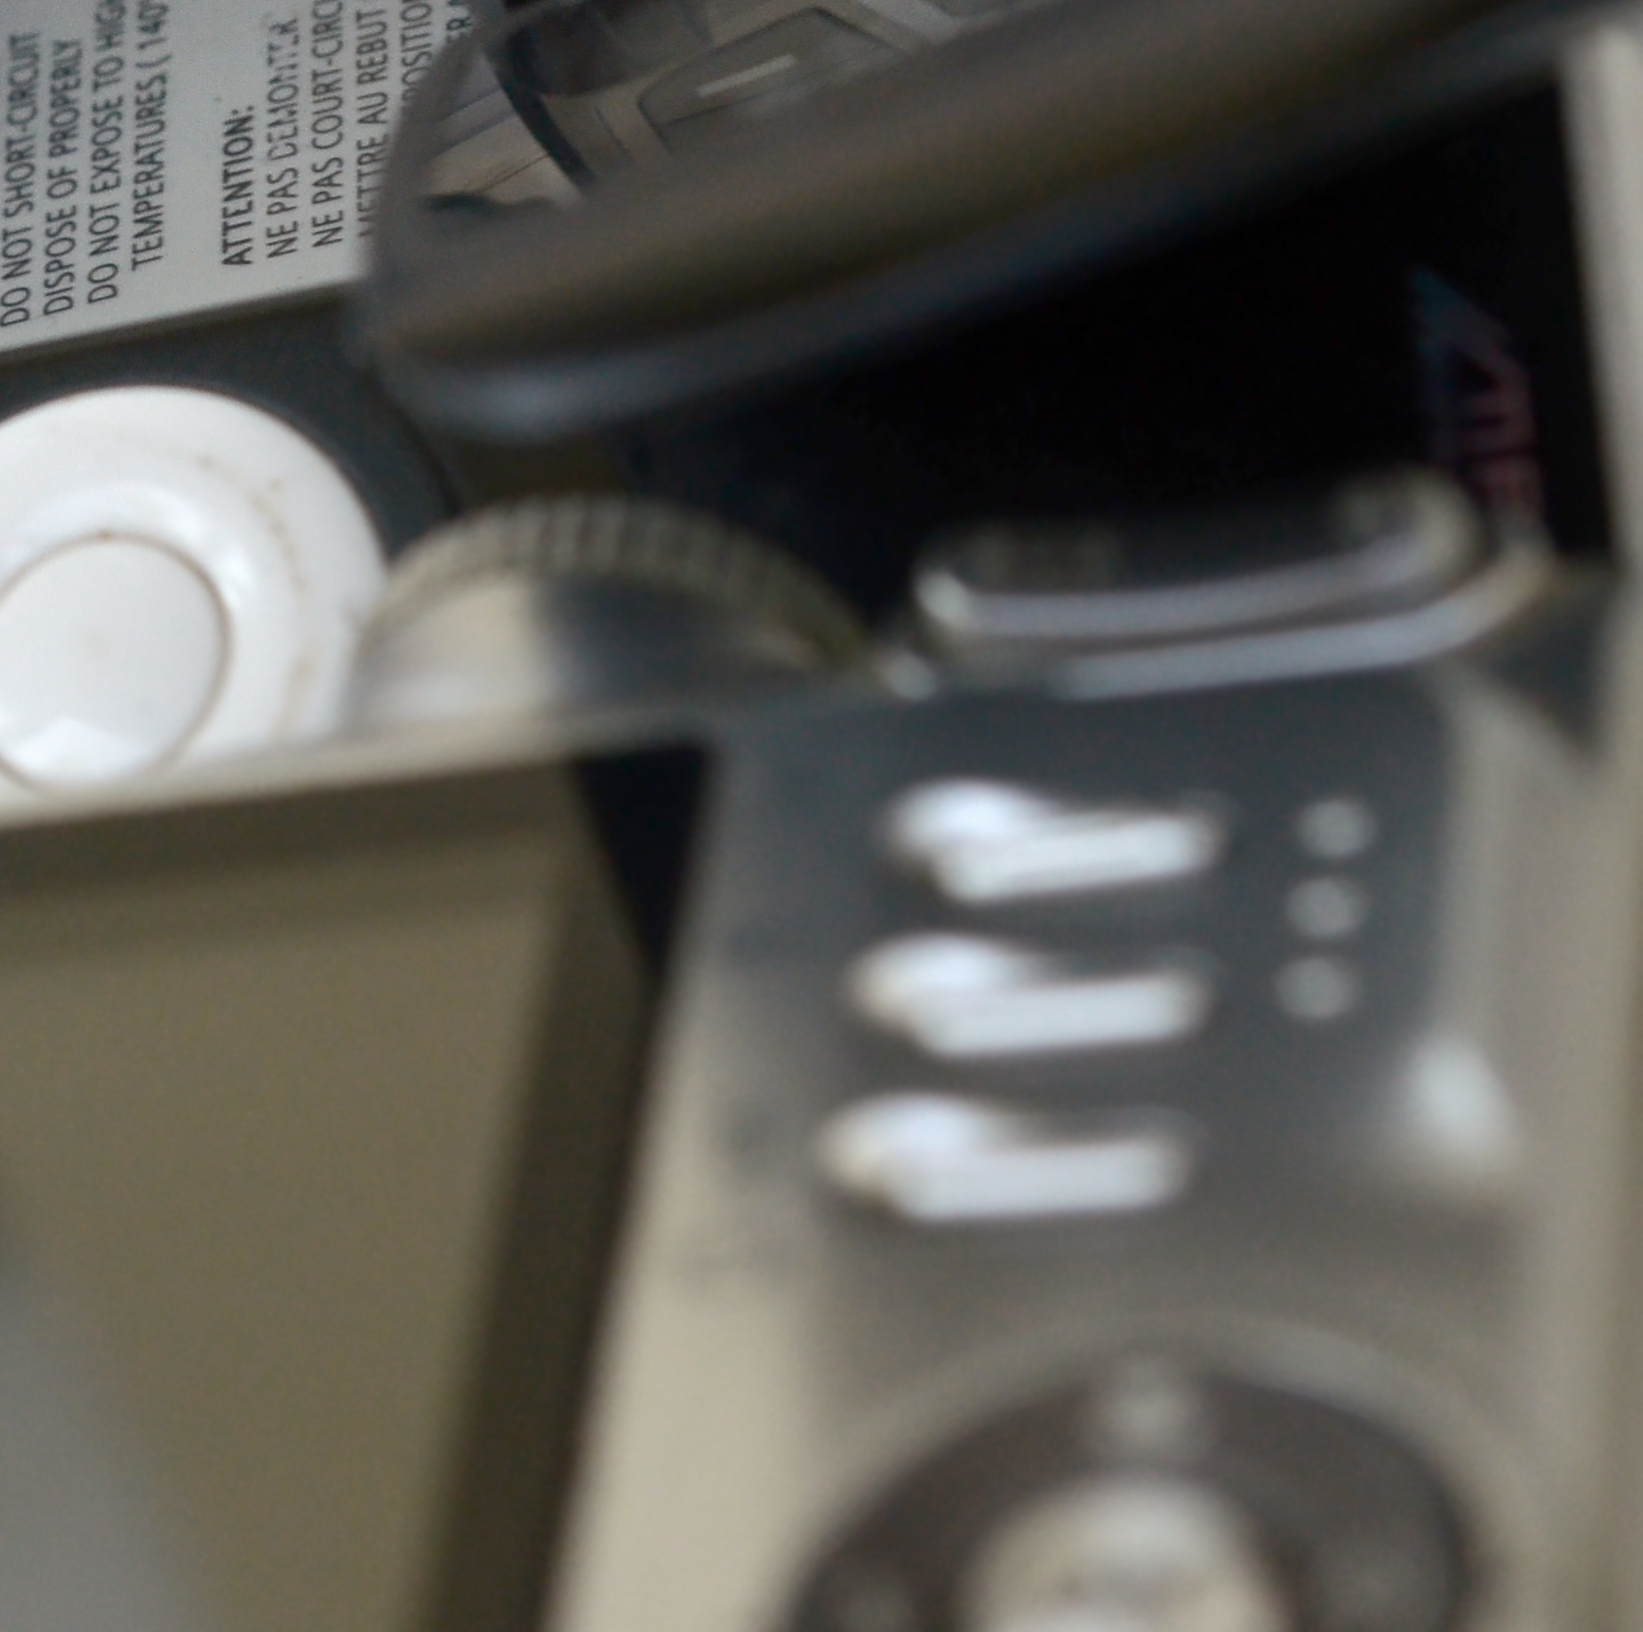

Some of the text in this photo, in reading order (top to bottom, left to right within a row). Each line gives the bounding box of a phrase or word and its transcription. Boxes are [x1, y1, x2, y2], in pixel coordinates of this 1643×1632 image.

[356, 7, 389, 84] REBUT
[93, 56, 123, 93] TO
[357, 92, 389, 124] AU
[89, 95, 123, 194] EXPOSE
[0, 31, 41, 327] DO NOT SHORT-CIRCUIT
[43, 39, 82, 315] DISPOSE OF PROPERLY
[131, 74, 167, 271] TEMPERATURES
[221, 106, 255, 266] ATTENTION:
[267, 167, 298, 216] PAS
[311, 157, 343, 204] PAS
[89, 203, 120, 256] NOT
[266, 221, 298, 258] NE
[311, 210, 343, 248] NE
[87, 263, 118, 303] DO
